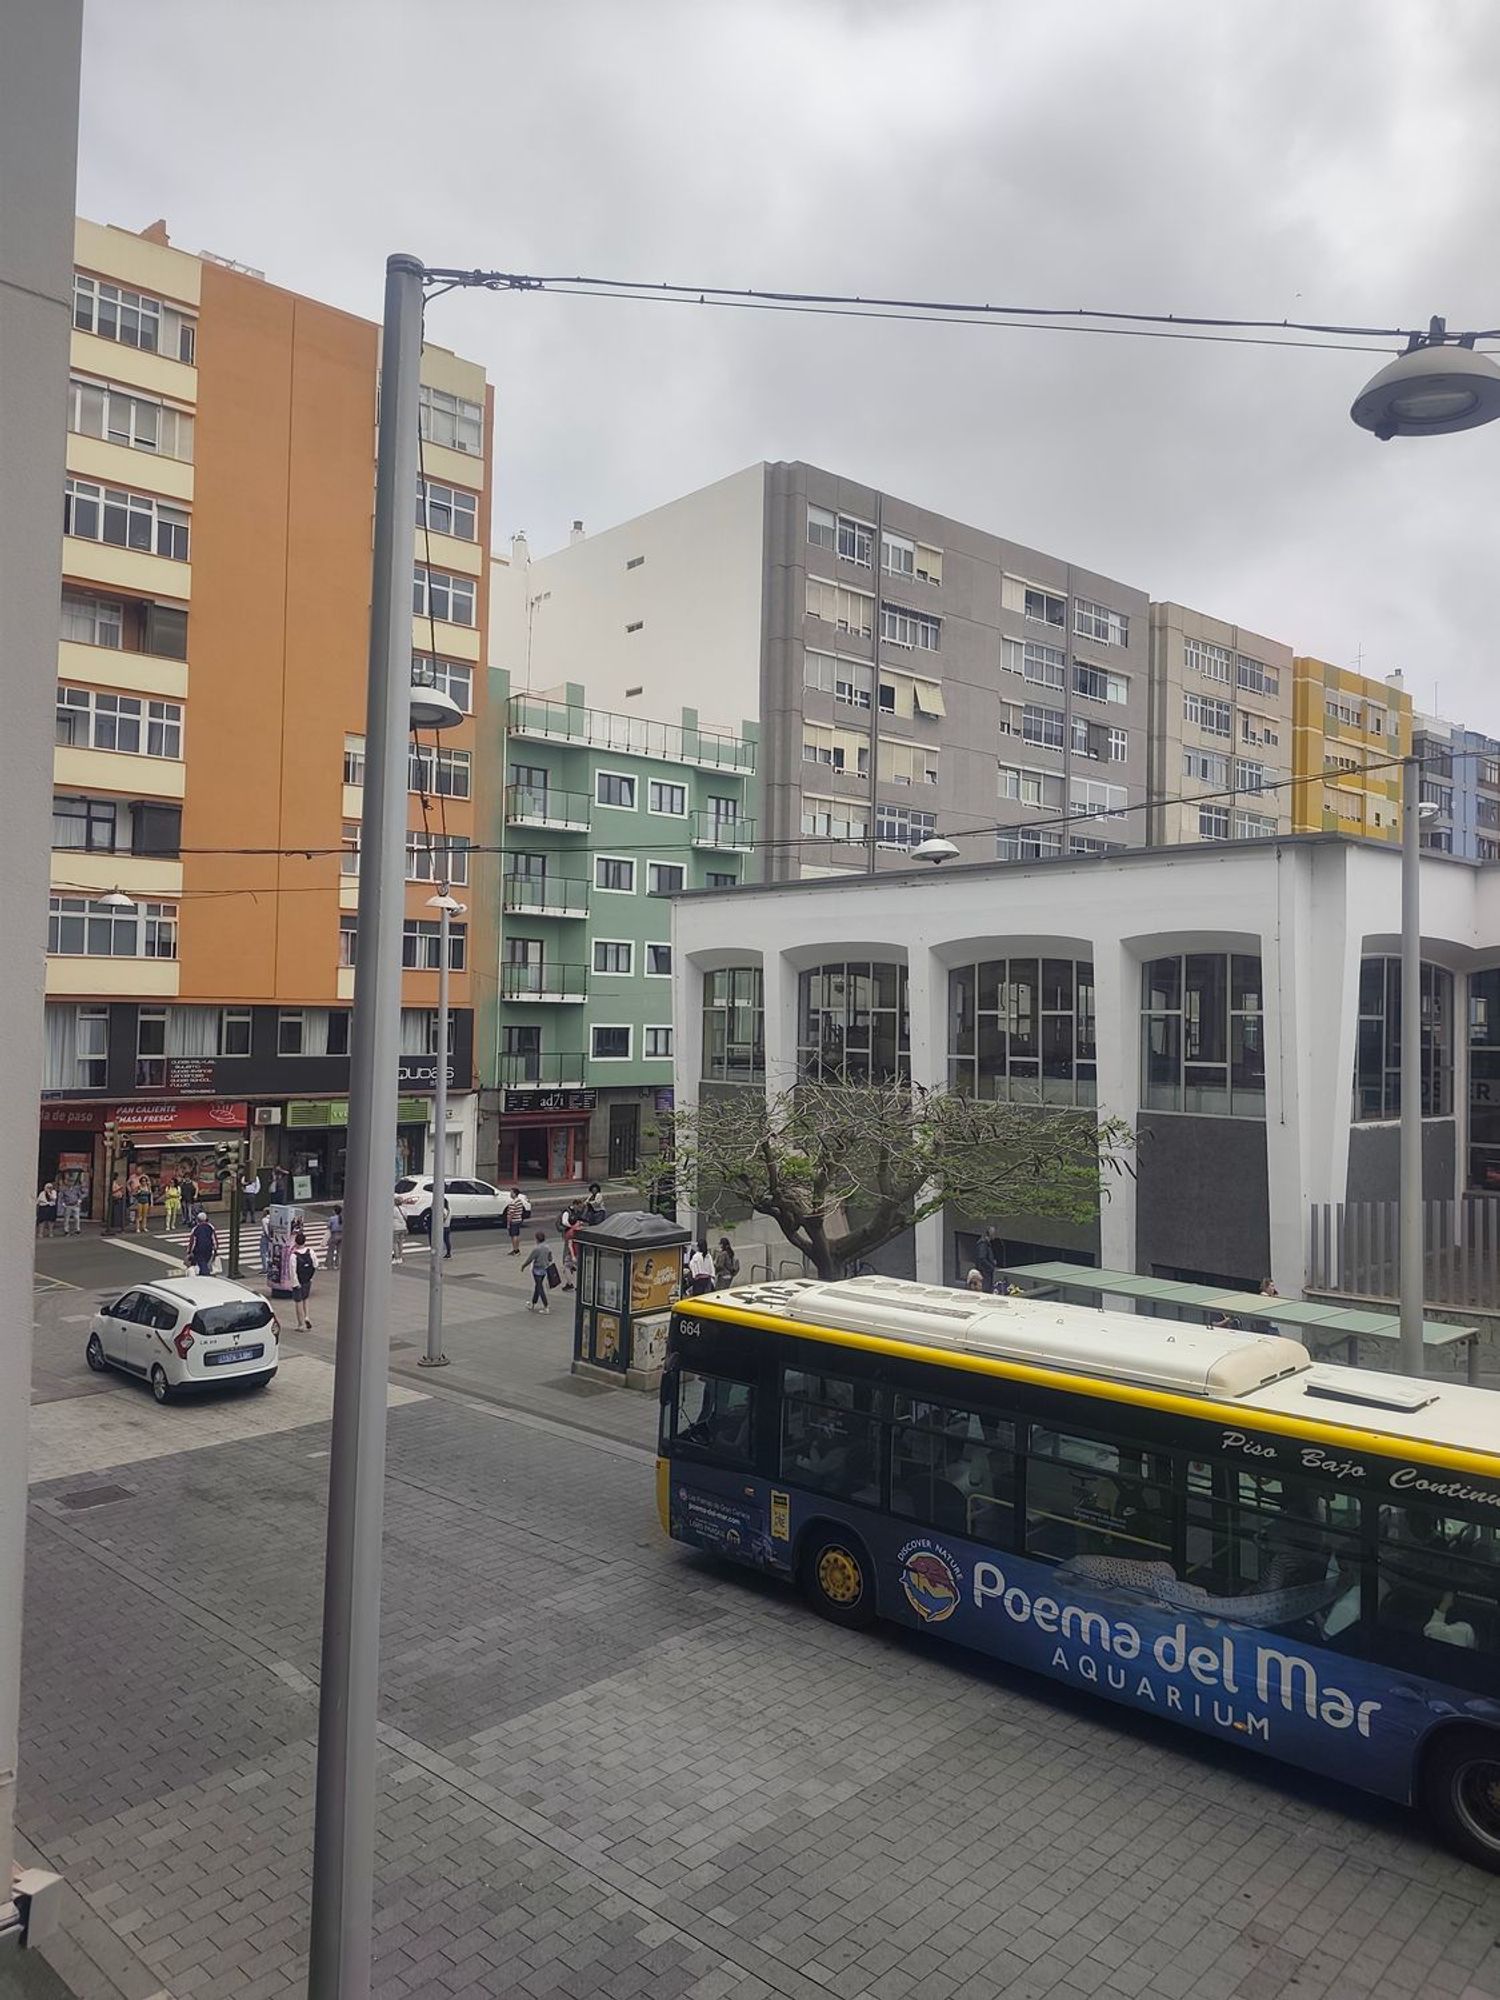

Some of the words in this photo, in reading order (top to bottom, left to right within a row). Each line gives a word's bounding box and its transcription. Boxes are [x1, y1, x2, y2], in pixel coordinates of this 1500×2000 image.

[136, 1104, 177, 1114] CALIENTE
[679, 1319, 700, 1337] 664
[1221, 1430, 1278, 1459] Piso
[1301, 1449, 1367, 1479] Bajo
[897, 1538, 932, 1562] DISCOVER
[935, 1544, 964, 1580] NATURE
[972, 1561, 1141, 1660] Poema
[1153, 1623, 1239, 1695] del
[1051, 1646, 1271, 1741] AQUARIUM
